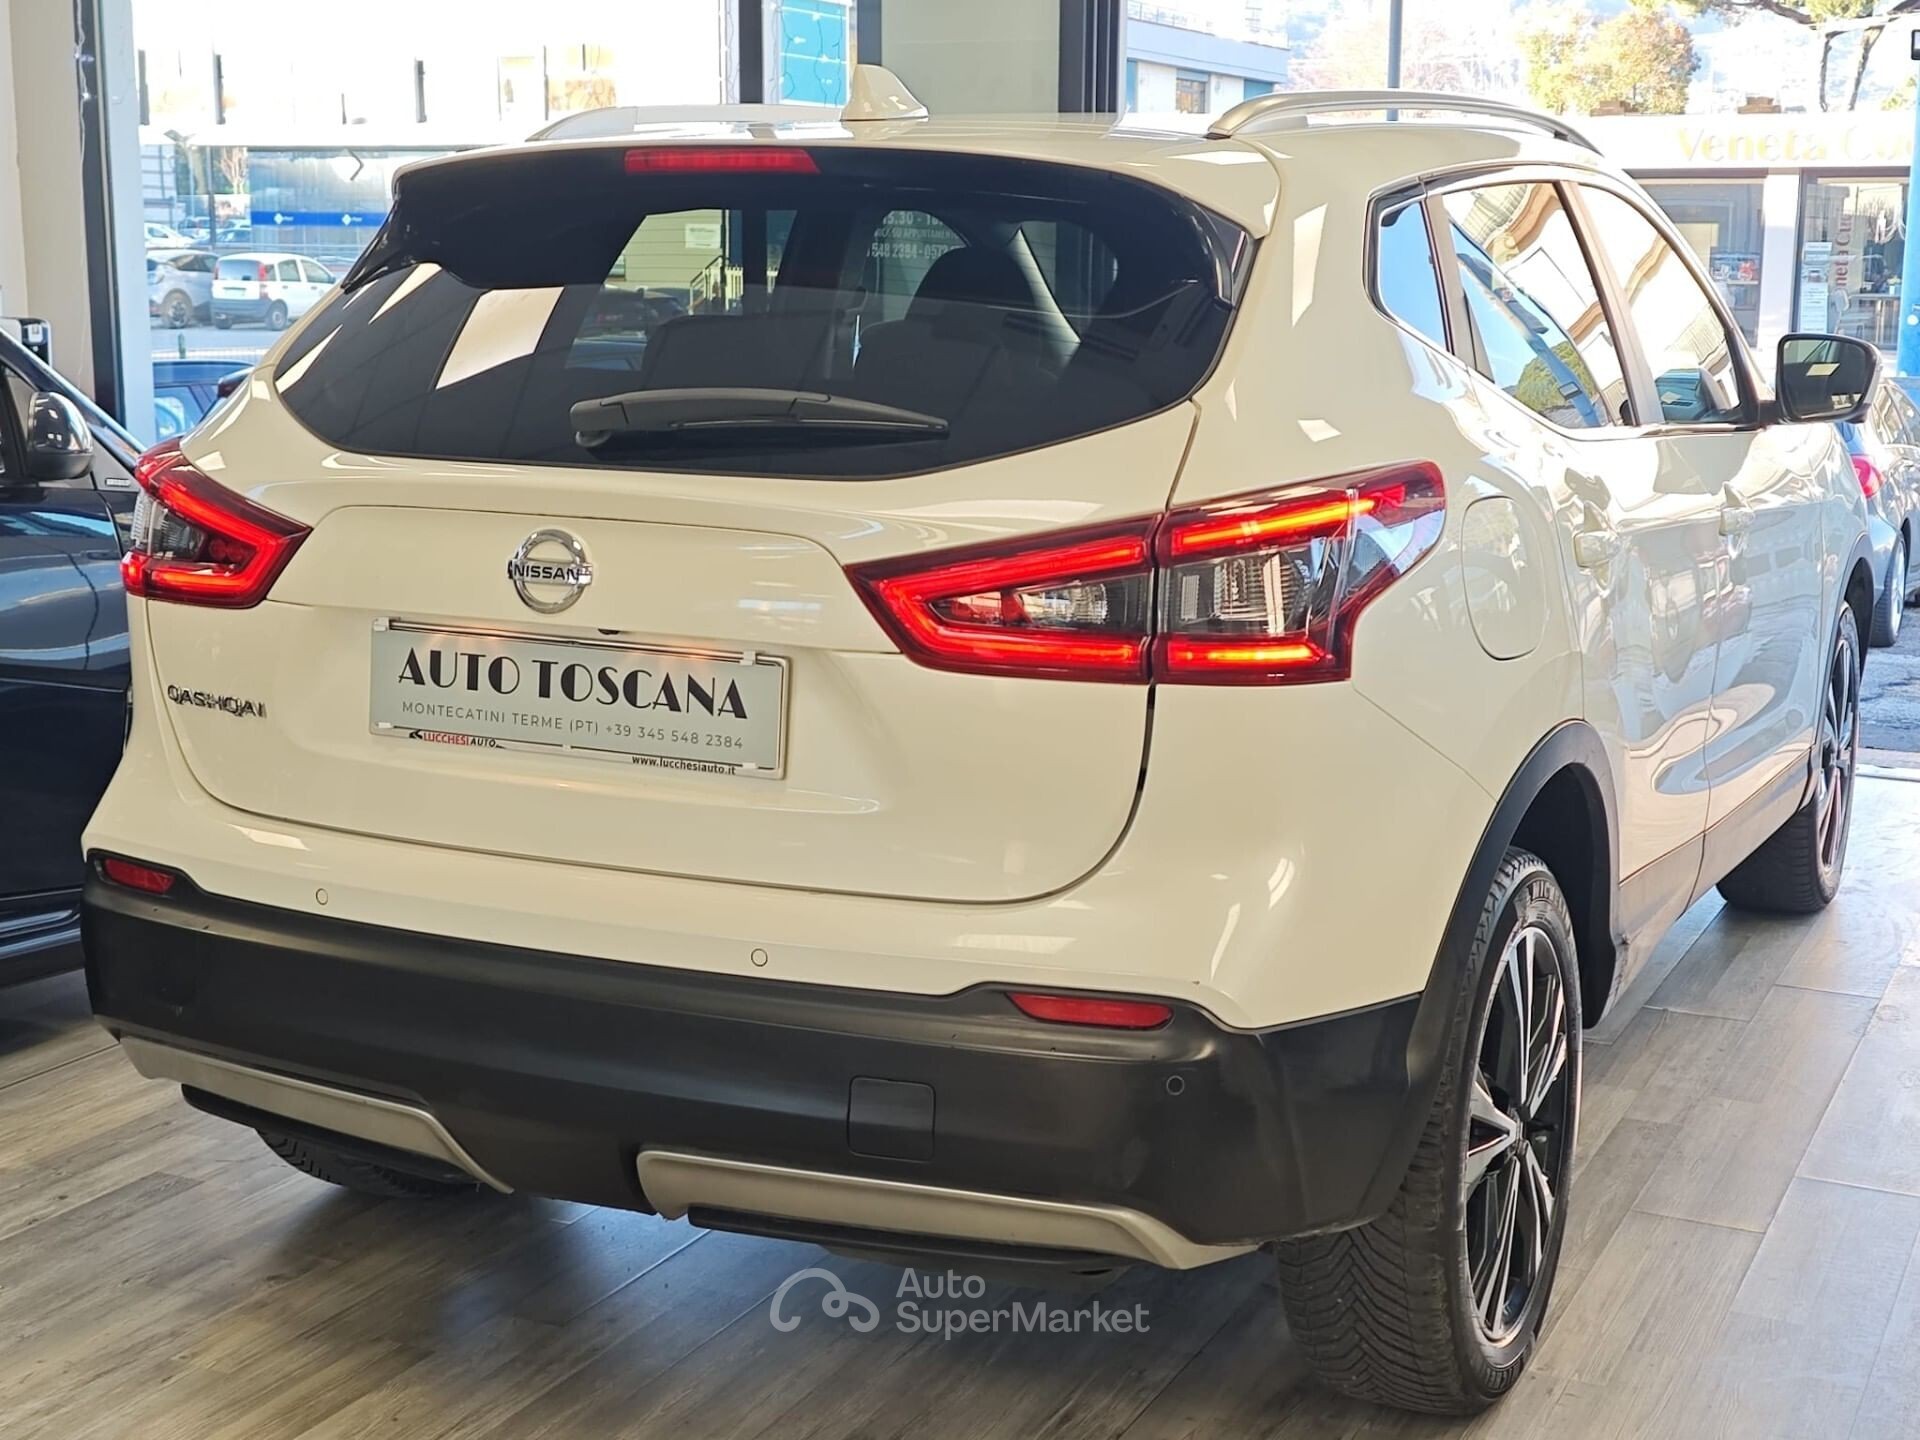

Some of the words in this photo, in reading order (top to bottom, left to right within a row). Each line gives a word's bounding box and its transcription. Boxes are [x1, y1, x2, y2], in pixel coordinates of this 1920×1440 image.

[1679, 128, 1827, 161] Veneta
[1841, 126, 1912, 161] Cu
[513, 564, 580, 581] NISSAN
[398, 647, 520, 694] AUTO
[532, 660, 748, 719] TOSCANA
[167, 684, 266, 718] QASHQAI
[402, 701, 505, 723] MONTECATINI
[511, 712, 563, 730] TERME
[569, 719, 598, 736] (PT)
[605, 723, 631, 737] +39
[638, 726, 665, 741] 345
[671, 730, 699, 745] 548
[705, 734, 743, 749] 2384
[632, 755, 736, 775] www.lucchesiauto.it
